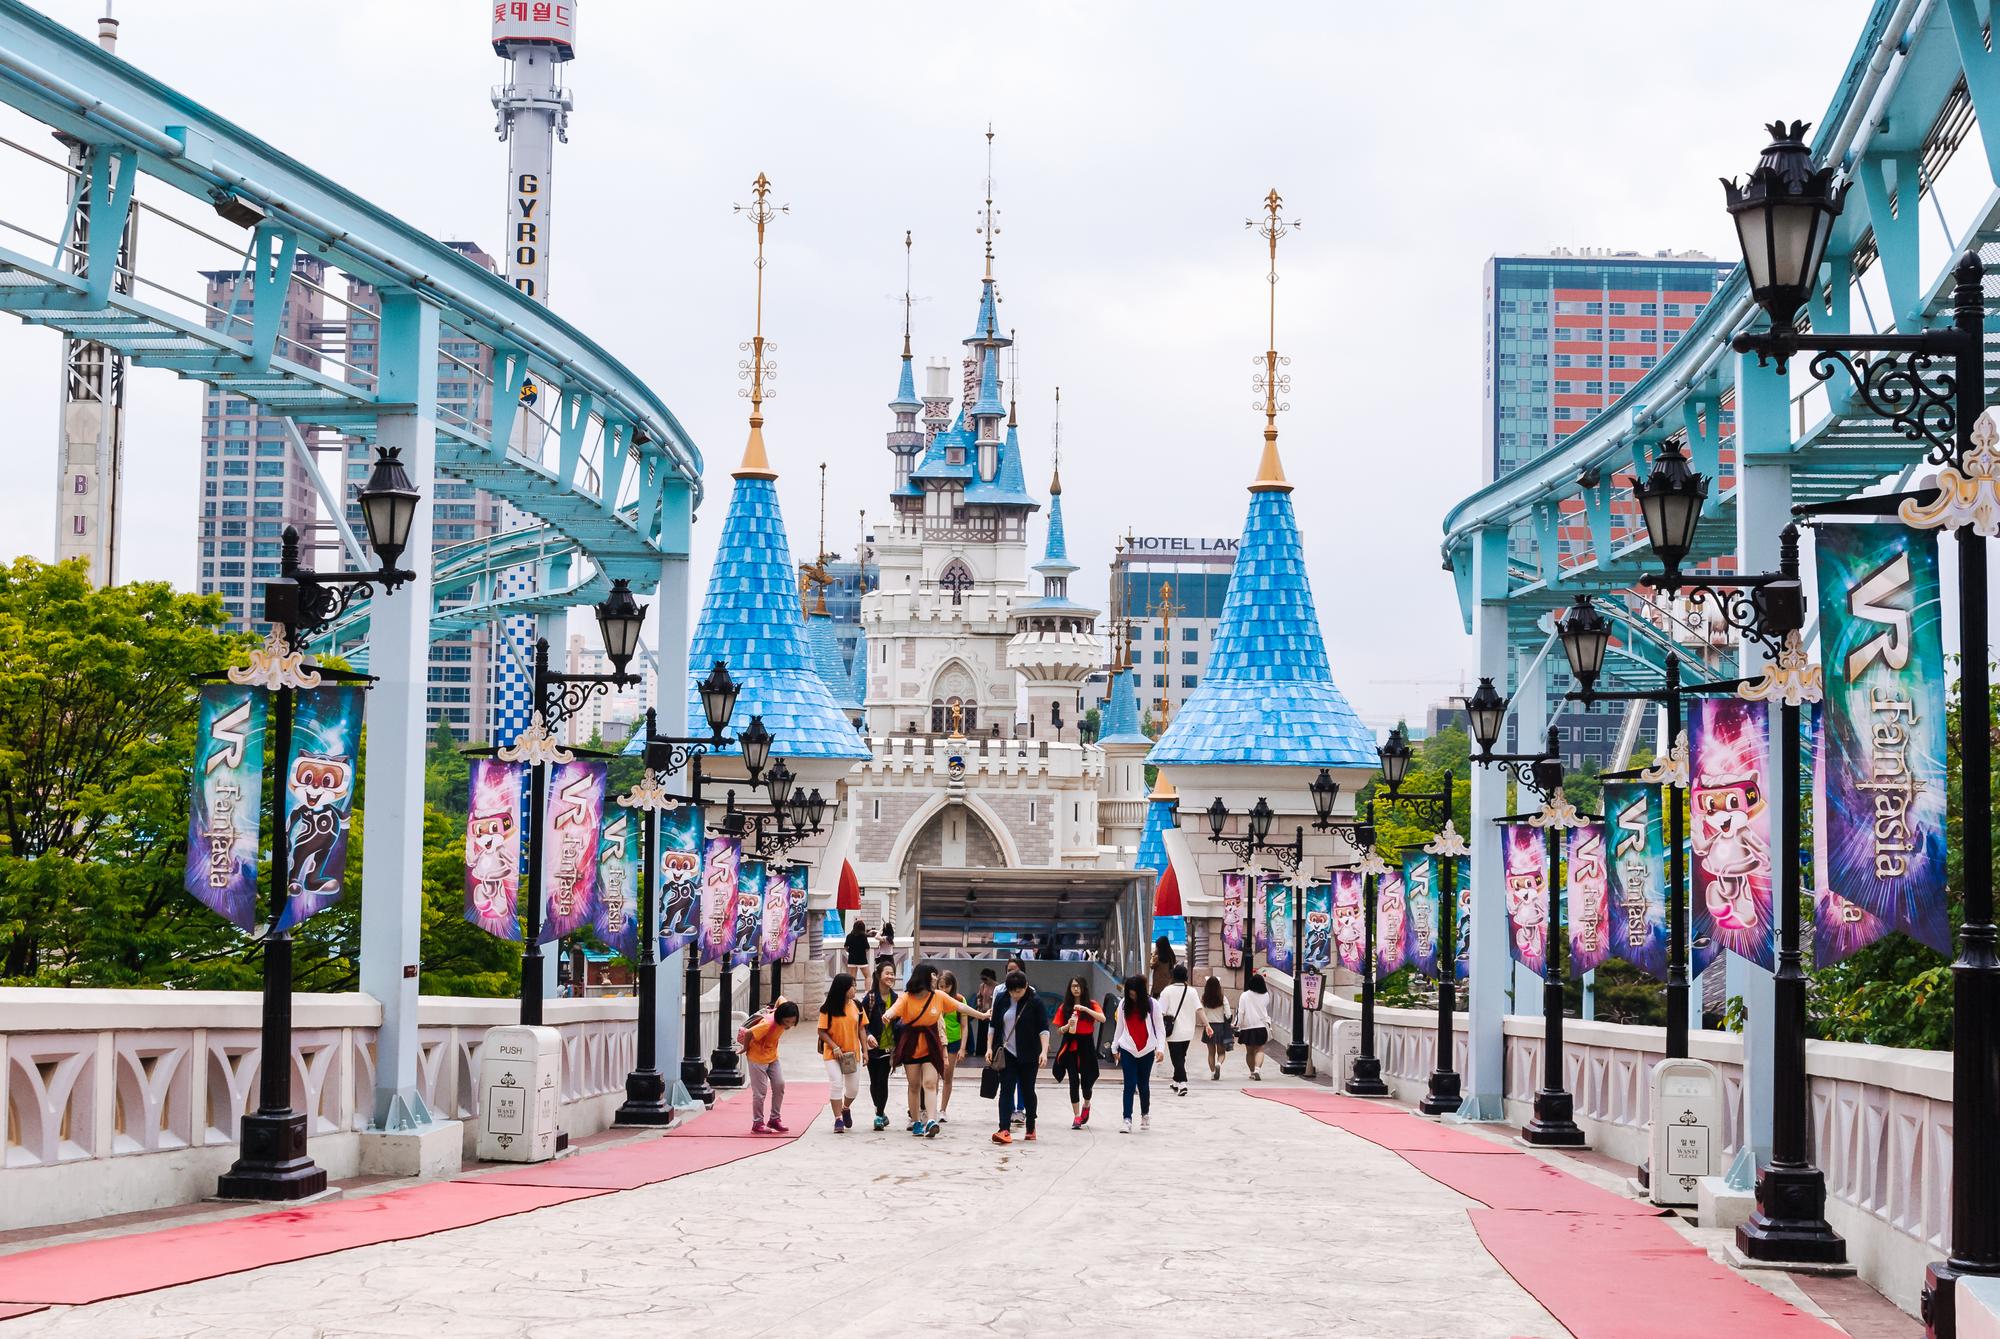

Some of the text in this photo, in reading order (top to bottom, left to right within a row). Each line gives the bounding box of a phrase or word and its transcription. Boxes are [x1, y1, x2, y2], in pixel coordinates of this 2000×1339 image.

[495, 2, 569, 27] 롯데월드
[73, 474, 89, 562] BU
[1129, 537, 1194, 550] HOTEL
[1845, 550, 1922, 881] VR Fantasia
[202, 700, 251, 889] VR Fantasia
[554, 773, 593, 916] VR Fantasia
[602, 815, 627, 933] VR Fantasia
[708, 847, 733, 886] VR
[1617, 796, 1649, 947] VR Fantasia
[1271, 888, 1286, 919] VR
[1382, 878, 1401, 912] VR
[1409, 859, 1429, 899] VR
[1574, 834, 1602, 952] VR Fantasia
[500, 1045, 522, 1055] PUSH
